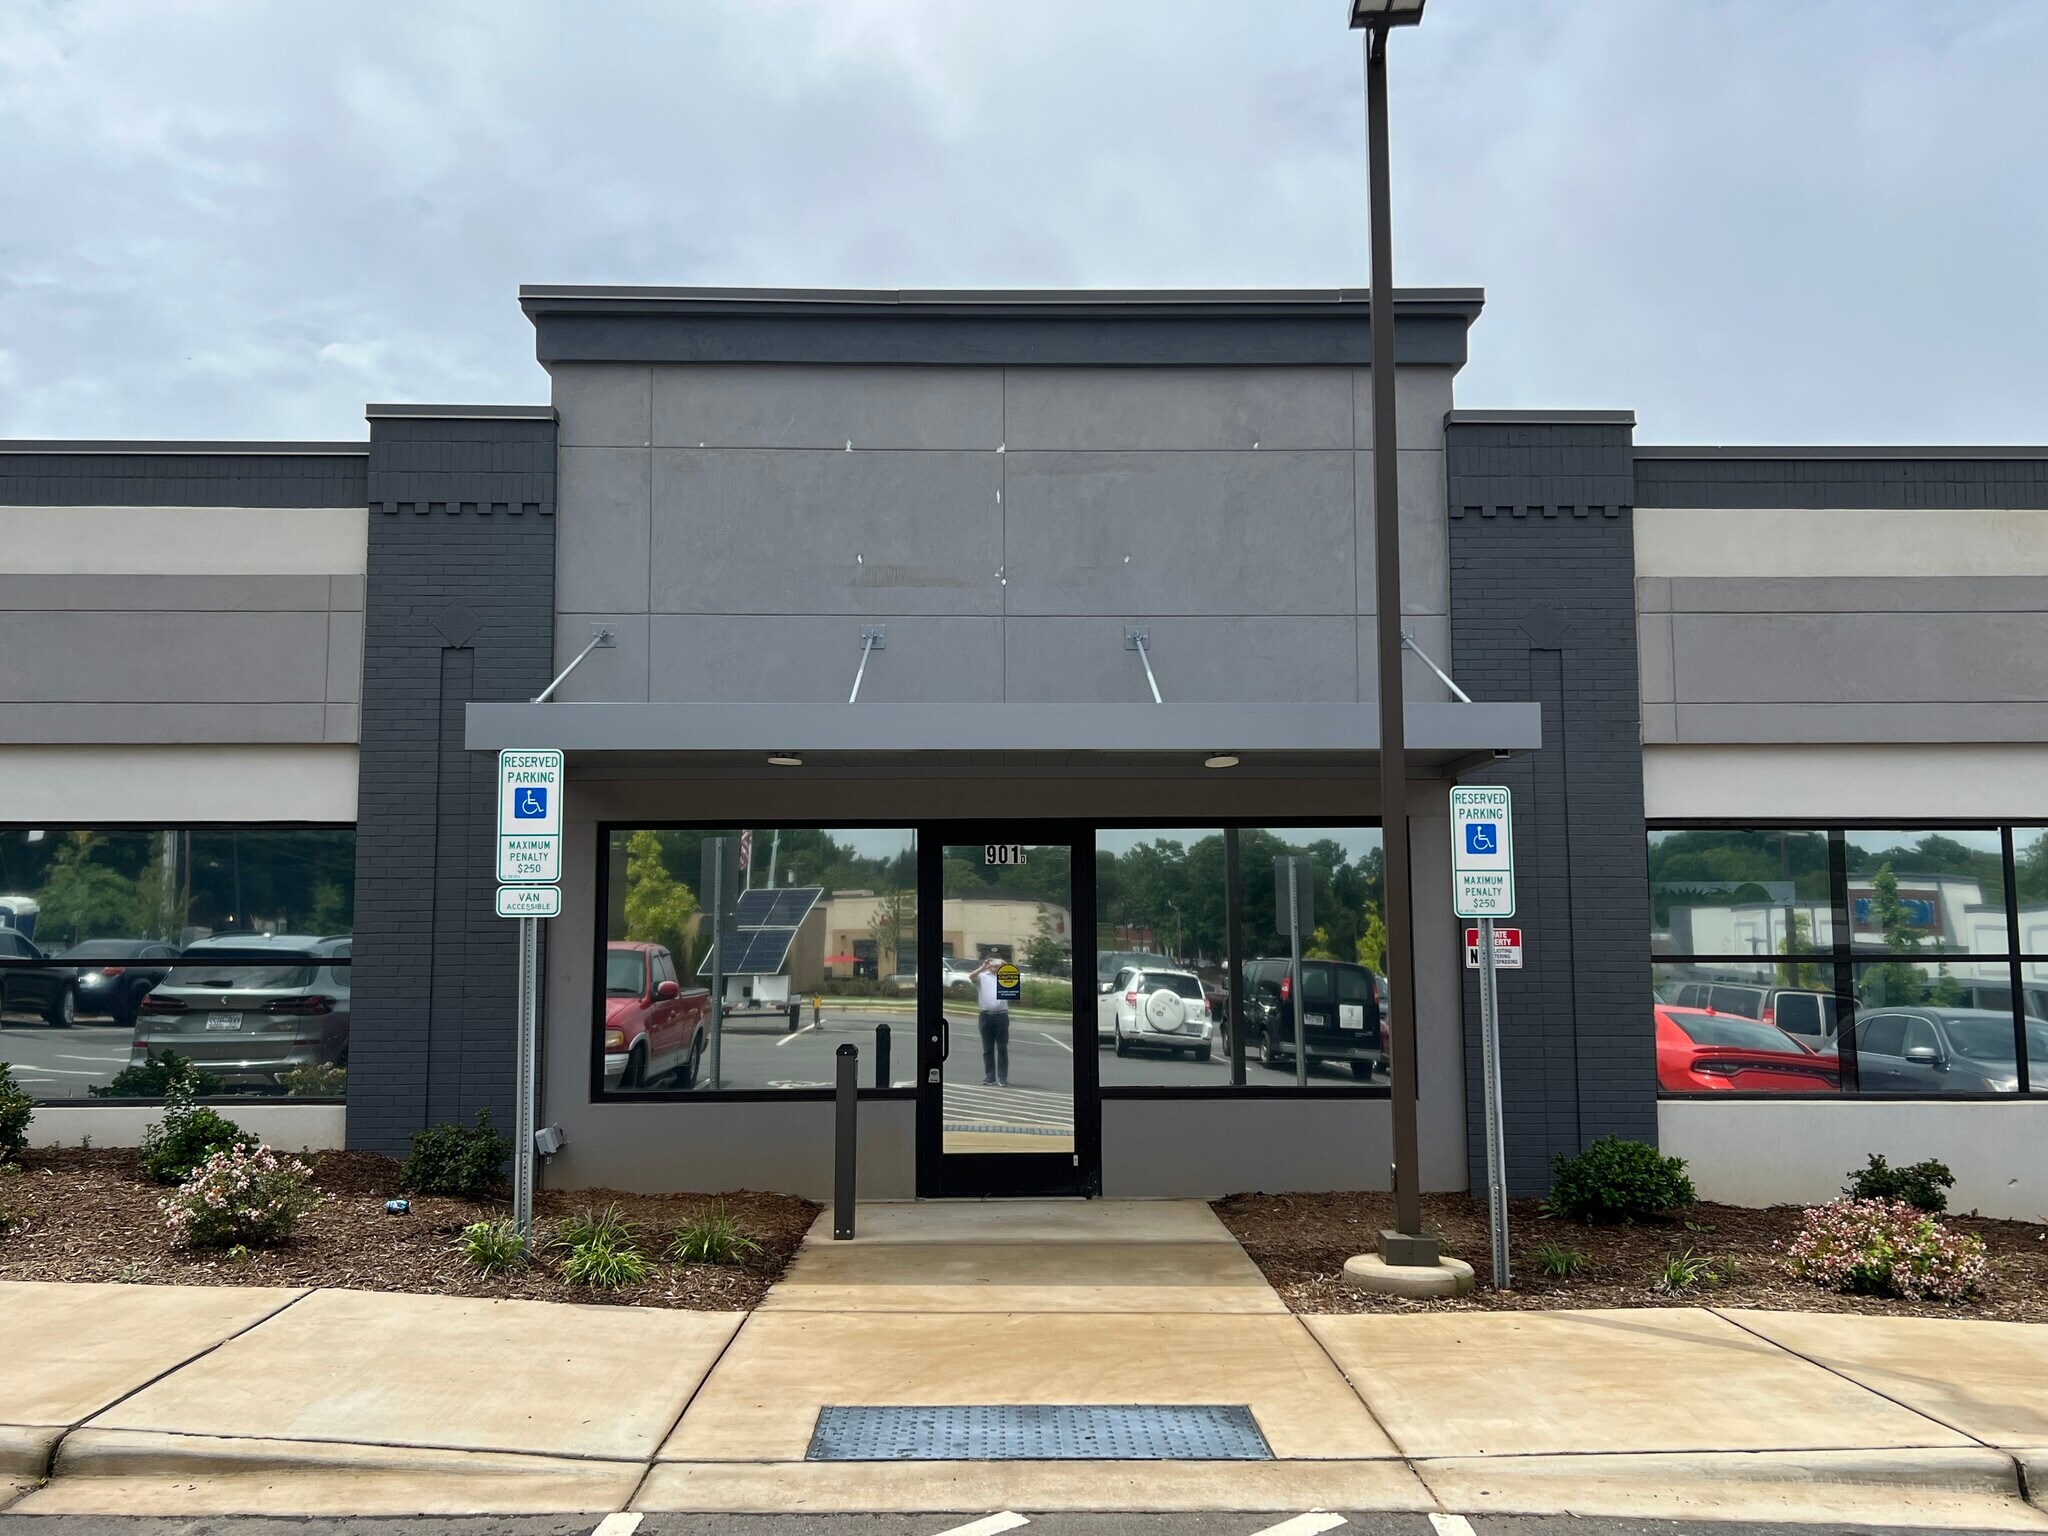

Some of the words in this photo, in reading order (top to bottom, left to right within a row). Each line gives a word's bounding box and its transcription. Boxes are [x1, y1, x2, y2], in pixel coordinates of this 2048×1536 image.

[504, 756, 558, 768] RESERVED
[507, 771, 555, 783] PARKING
[1455, 793, 1506, 805] RESERVED
[1458, 808, 1503, 820] PARKING
[508, 840, 551, 850] MAXIMUM
[509, 852, 549, 862] PENALTY
[517, 863, 541, 874] $250
[1463, 876, 1504, 885] MAXIMUM
[518, 892, 540, 902] VAN
[1465, 887, 1502, 897] PENALTY
[1473, 898, 1496, 908] $250
